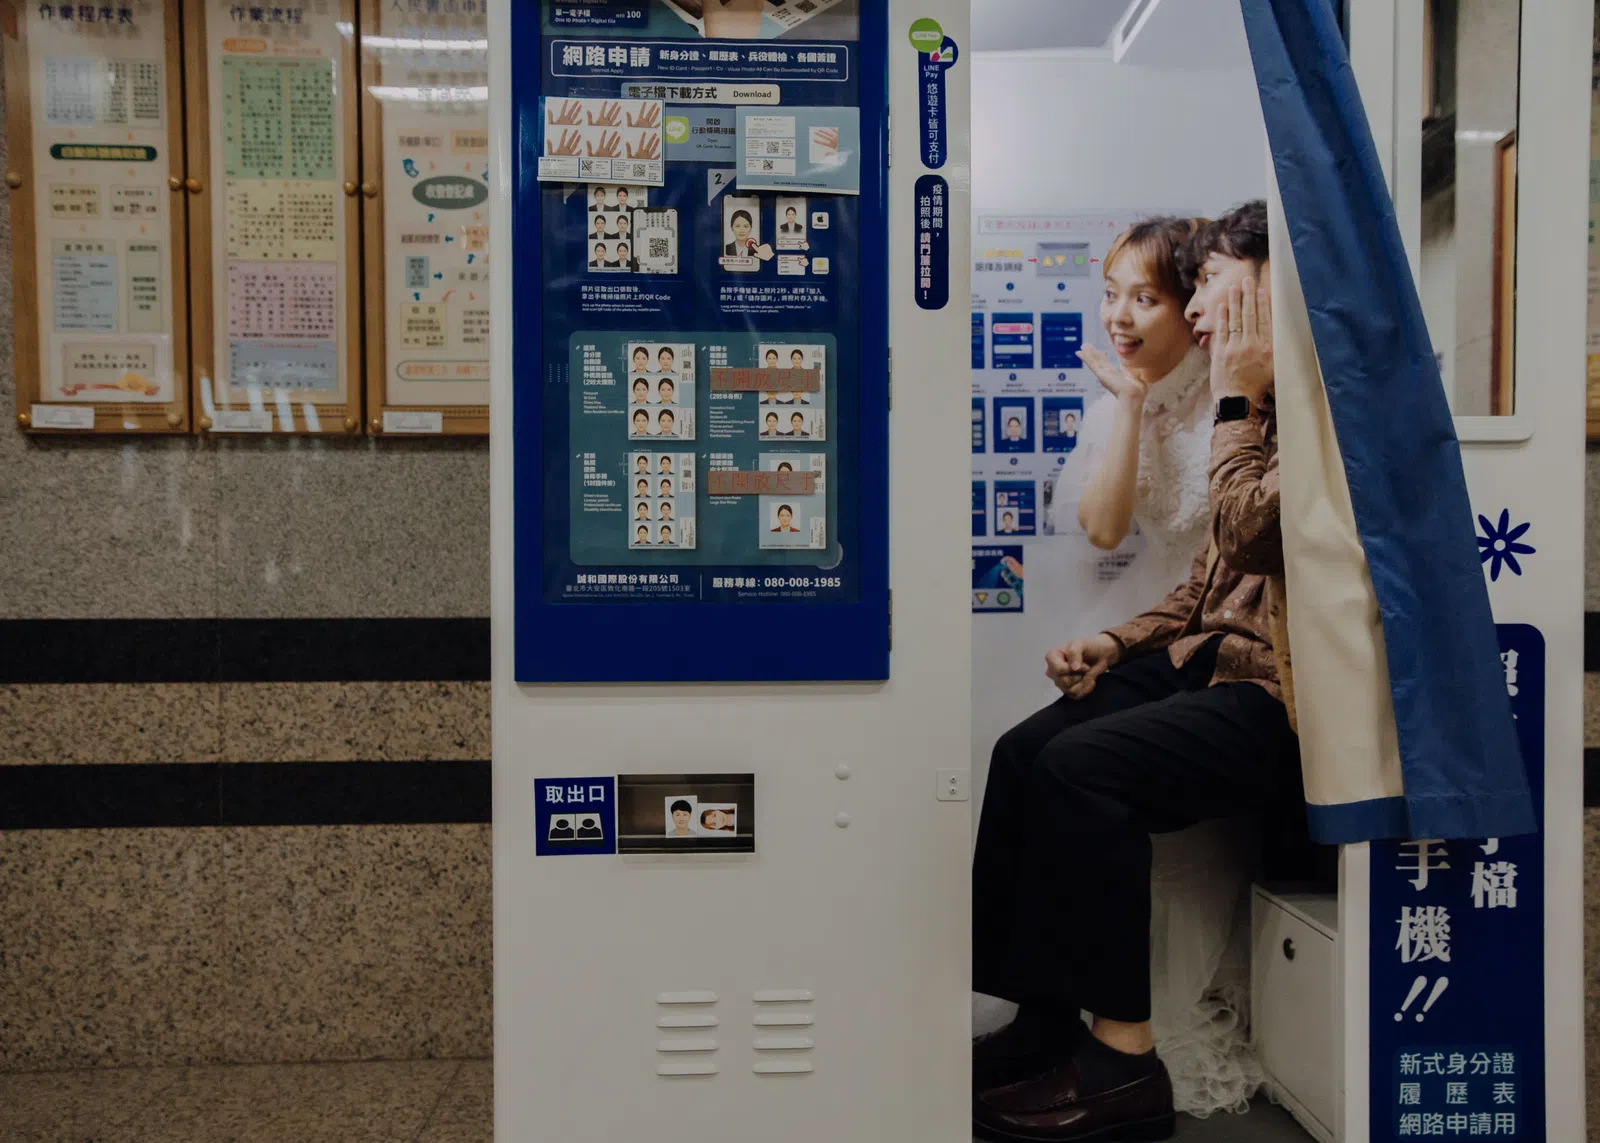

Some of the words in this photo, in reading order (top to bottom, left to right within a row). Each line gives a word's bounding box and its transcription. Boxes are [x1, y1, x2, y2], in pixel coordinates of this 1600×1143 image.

[39, 3, 133, 25] 作業程序表
[230, 4, 303, 25] 作業流程
[555, 8, 591, 17] 單一電子檔
[627, 11, 641, 19] 100
[562, 45, 650, 68] 網路申請
[926, 71, 938, 80] Pay
[628, 85, 718, 101] 電子檔下載方式
[733, 89, 771, 98] Download
[926, 83, 939, 164] 悠遊卡皆可支付
[715, 173, 726, 185] 2.
[711, 370, 811, 390] 不開放尺寸
[711, 472, 812, 491] 不開放尺寸
[576, 573, 679, 584] 誠和國際股份有限公司
[764, 577, 841, 588] 080-008-1985
[545, 784, 605, 804] 取出口
[1399, 1052, 1516, 1075] 新式身分證
[1399, 1112, 1516, 1136] 網路申請用
